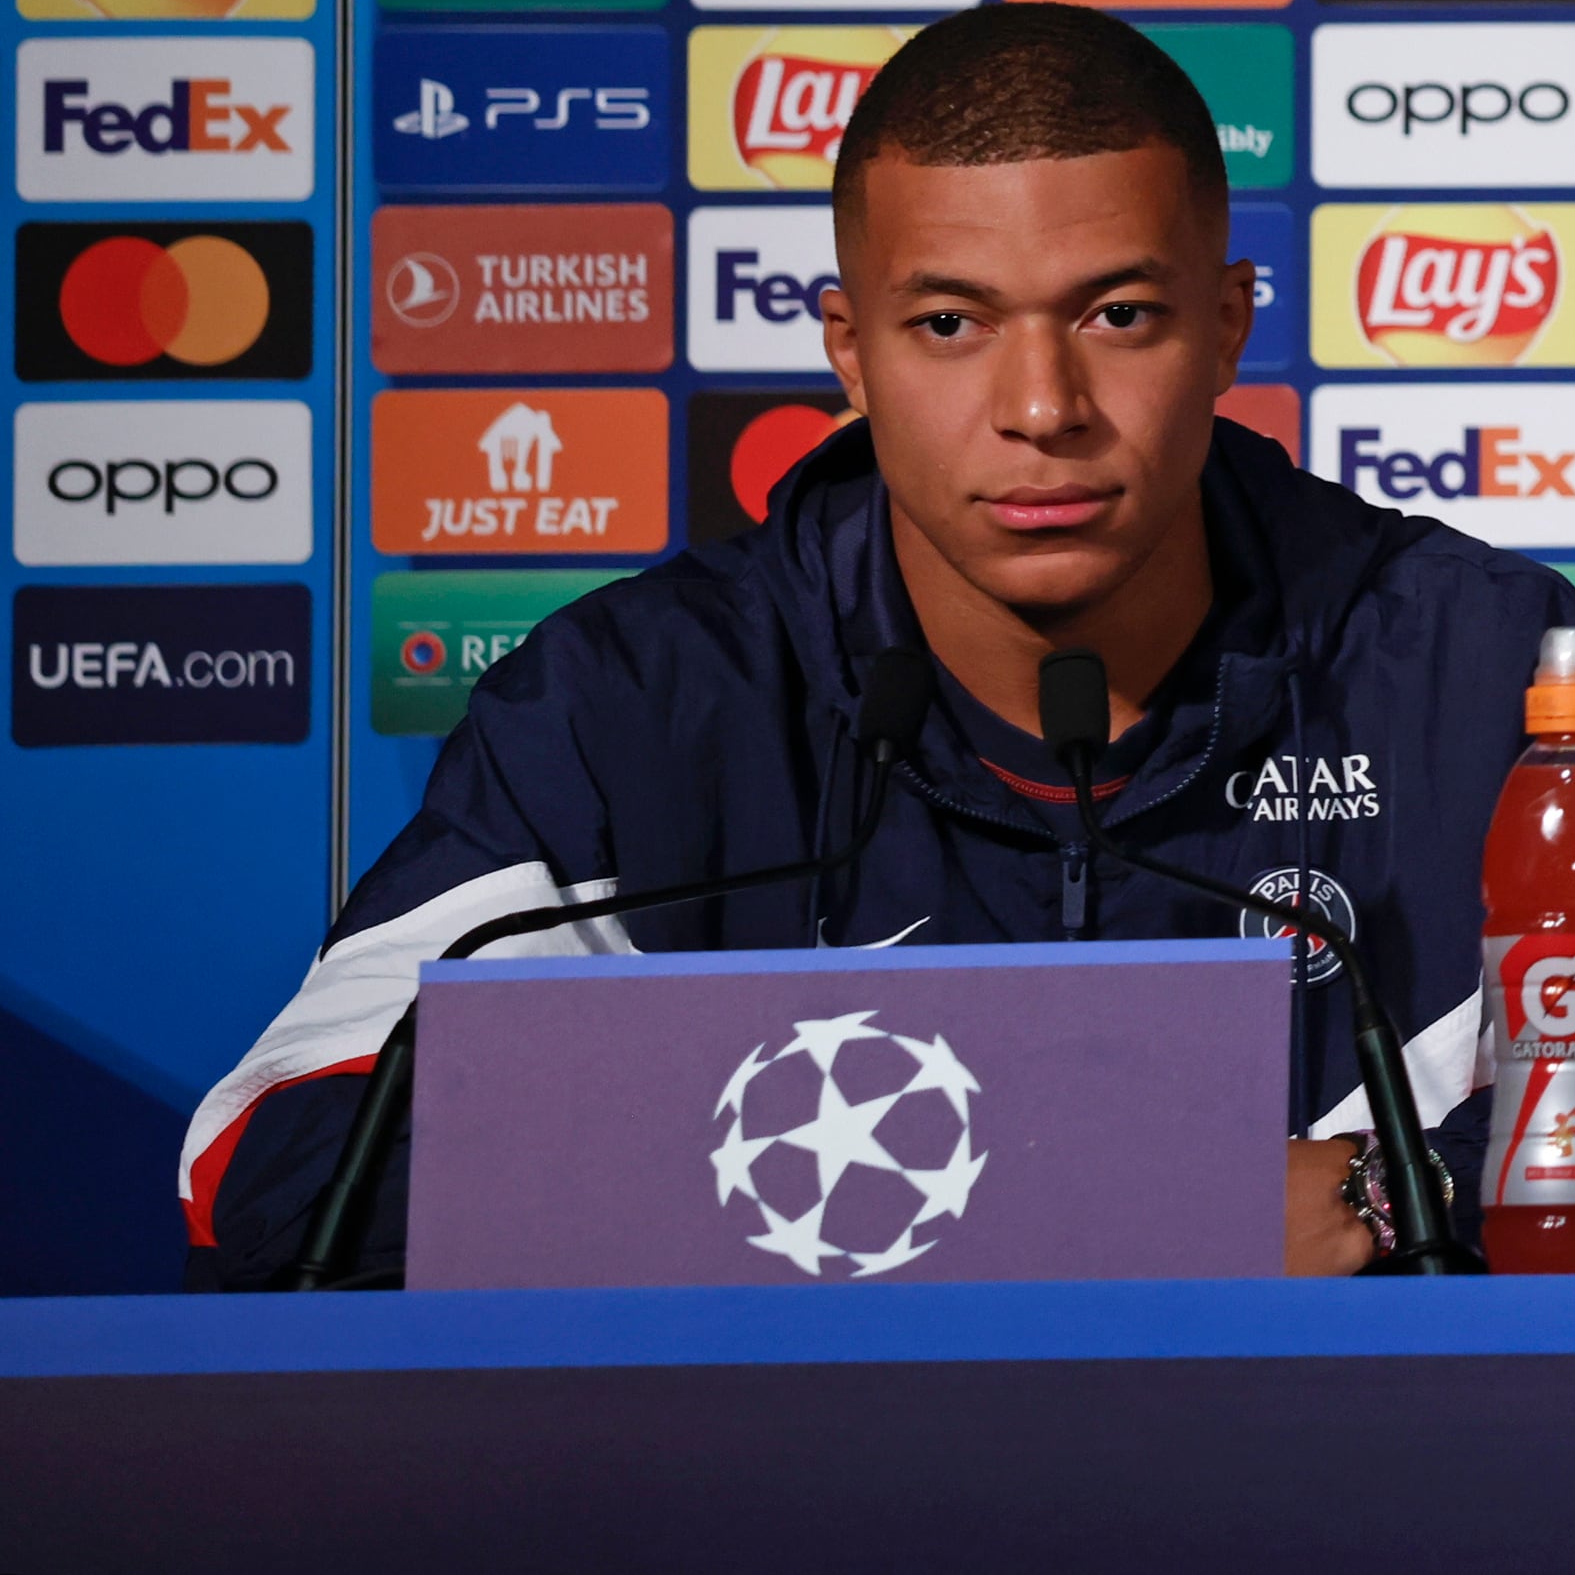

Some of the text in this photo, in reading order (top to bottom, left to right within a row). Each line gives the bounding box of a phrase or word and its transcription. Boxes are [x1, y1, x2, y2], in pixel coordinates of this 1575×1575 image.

[44, 79, 292, 154] FedEx
[486, 88, 650, 129] PS5
[1346, 83, 1570, 136] oppo
[478, 254, 647, 290] TURKISH
[1367, 236, 1549, 342] Lay's
[475, 289, 648, 322] AIRLINES
[47, 459, 278, 515] oppo
[422, 498, 618, 540] JUST EAT
[30, 643, 293, 688] UEFA.com
